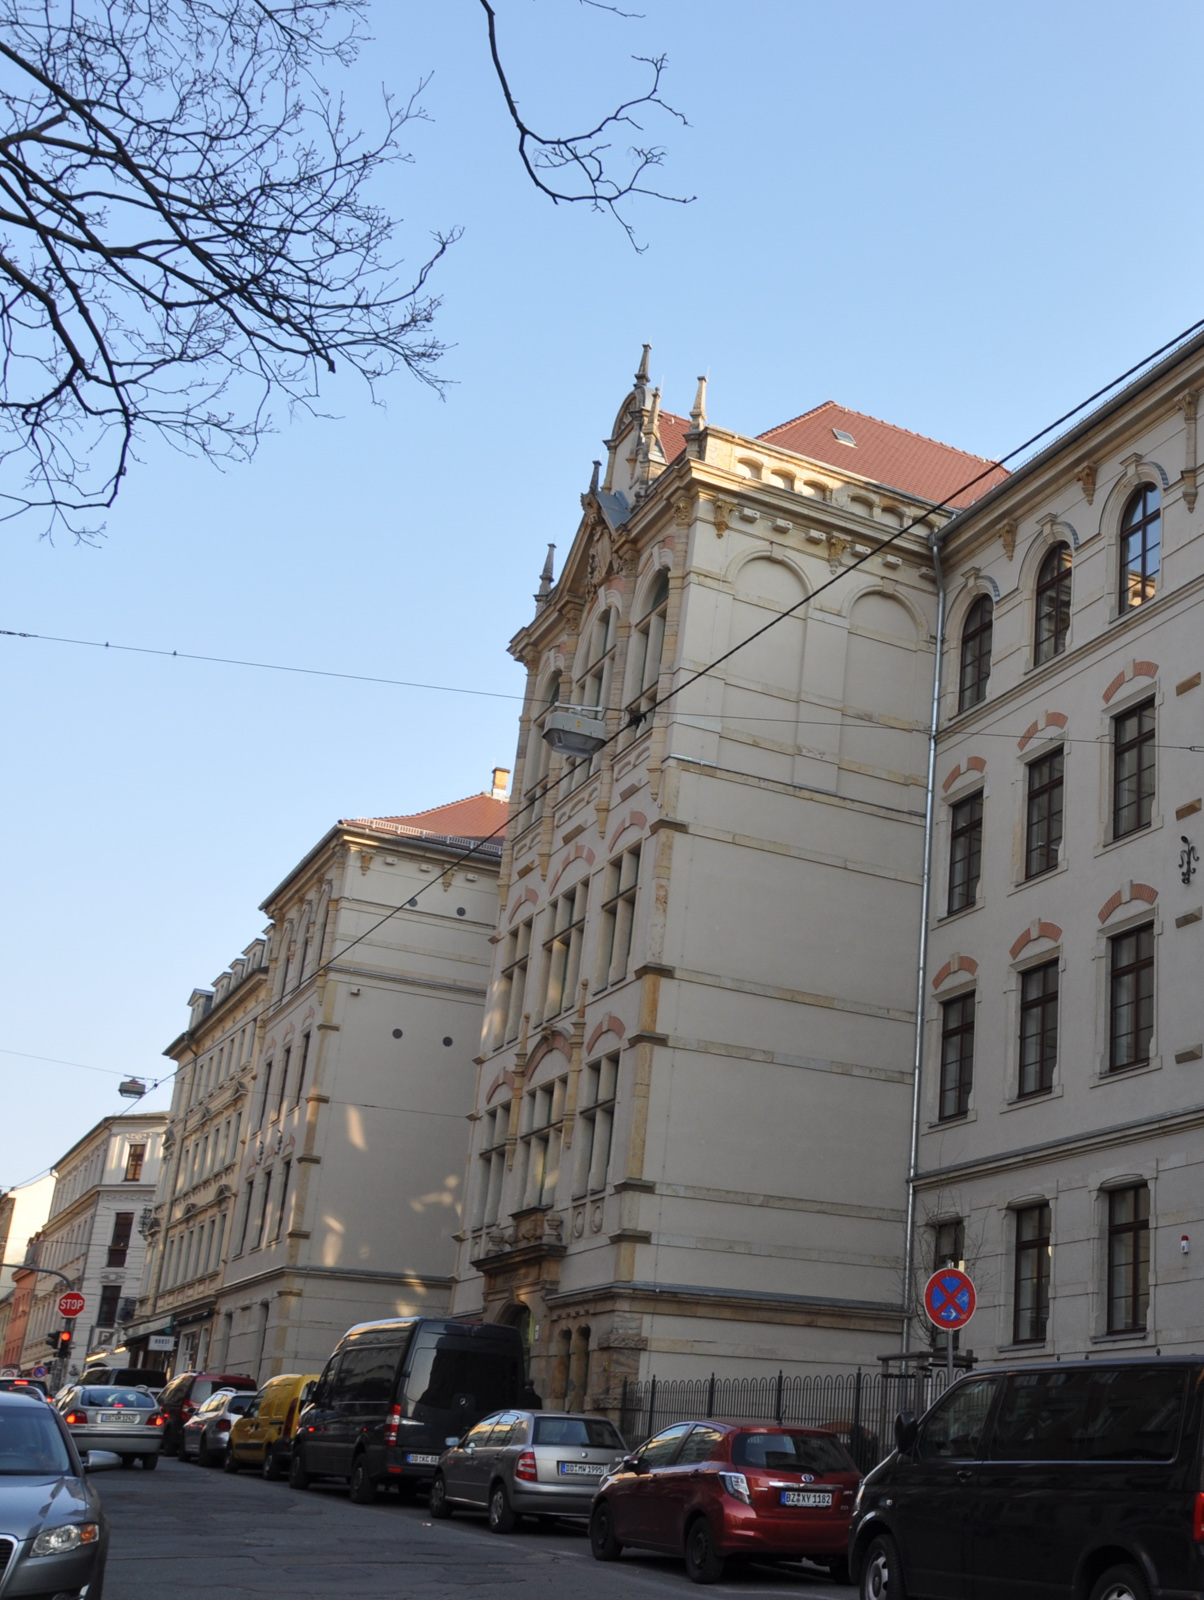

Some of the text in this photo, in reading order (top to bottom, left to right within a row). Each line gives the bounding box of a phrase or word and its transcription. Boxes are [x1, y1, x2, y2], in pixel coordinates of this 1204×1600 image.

[59, 1299, 84, 1310] STOP
[786, 1493, 831, 1504] BZ XY 1182
